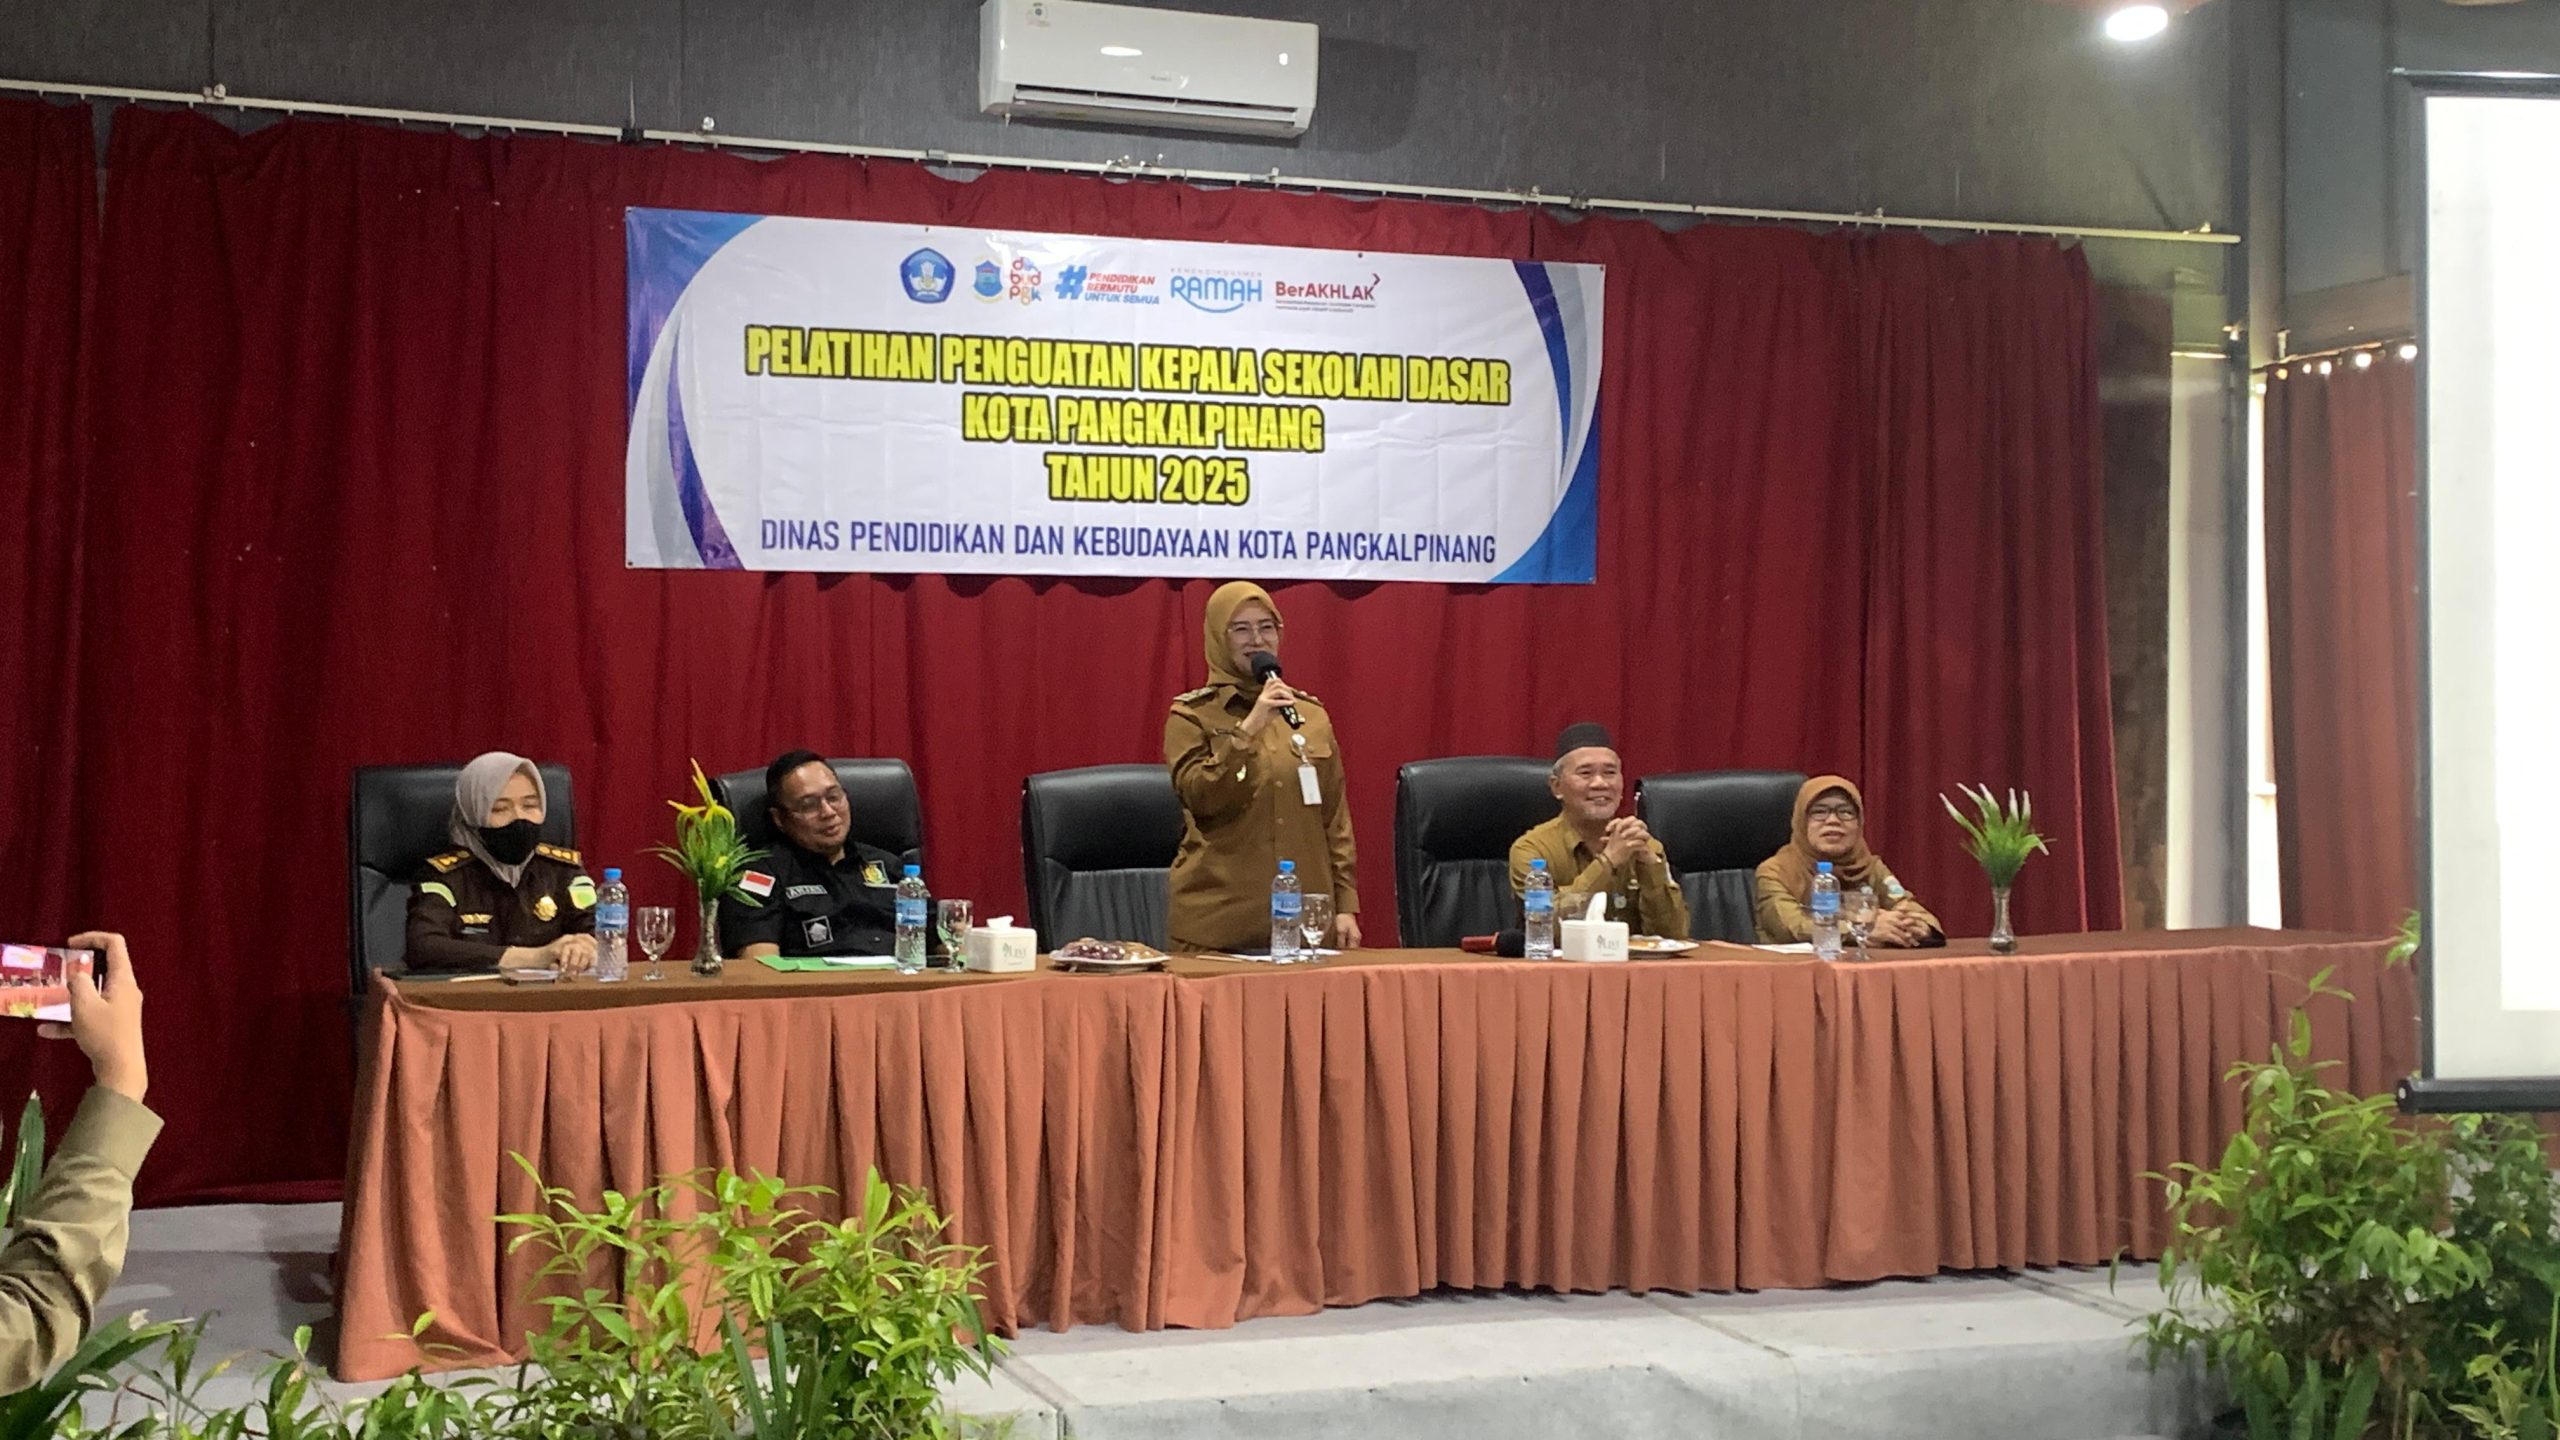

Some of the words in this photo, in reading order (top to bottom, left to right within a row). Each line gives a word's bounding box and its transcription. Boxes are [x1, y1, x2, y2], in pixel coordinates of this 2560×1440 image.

[1086, 283, 1138, 293] BERMUTU
[1088, 272, 1156, 285] PENDIDIKAN
[1170, 276, 1263, 304] RAMAH
[1275, 280, 1375, 301] BerAKHLAK
[1084, 293, 1120, 303] UNTUK
[1122, 295, 1160, 305] SEMUA
[745, 324, 936, 384] PELATIHAN
[940, 333, 1134, 390] PENGUATAN
[1139, 344, 1259, 395] KEPALA
[1262, 350, 1403, 400] SEKOLAH
[1405, 356, 1511, 406] DASAR
[963, 392, 1052, 443] KOTA
[1056, 396, 1325, 453] PANGKALPINANG
[1044, 452, 1157, 502] TAHUN
[1160, 455, 1250, 506] 2025
[761, 519, 840, 551] DINAS
[851, 521, 1005, 555] PENDIDIKAN
[1015, 525, 1064, 556] DAN
[1073, 526, 1230, 560] KEBUDAYAAN
[1239, 530, 1298, 560] KOTA
[1306, 531, 1496, 564] PANGKALPINANG
